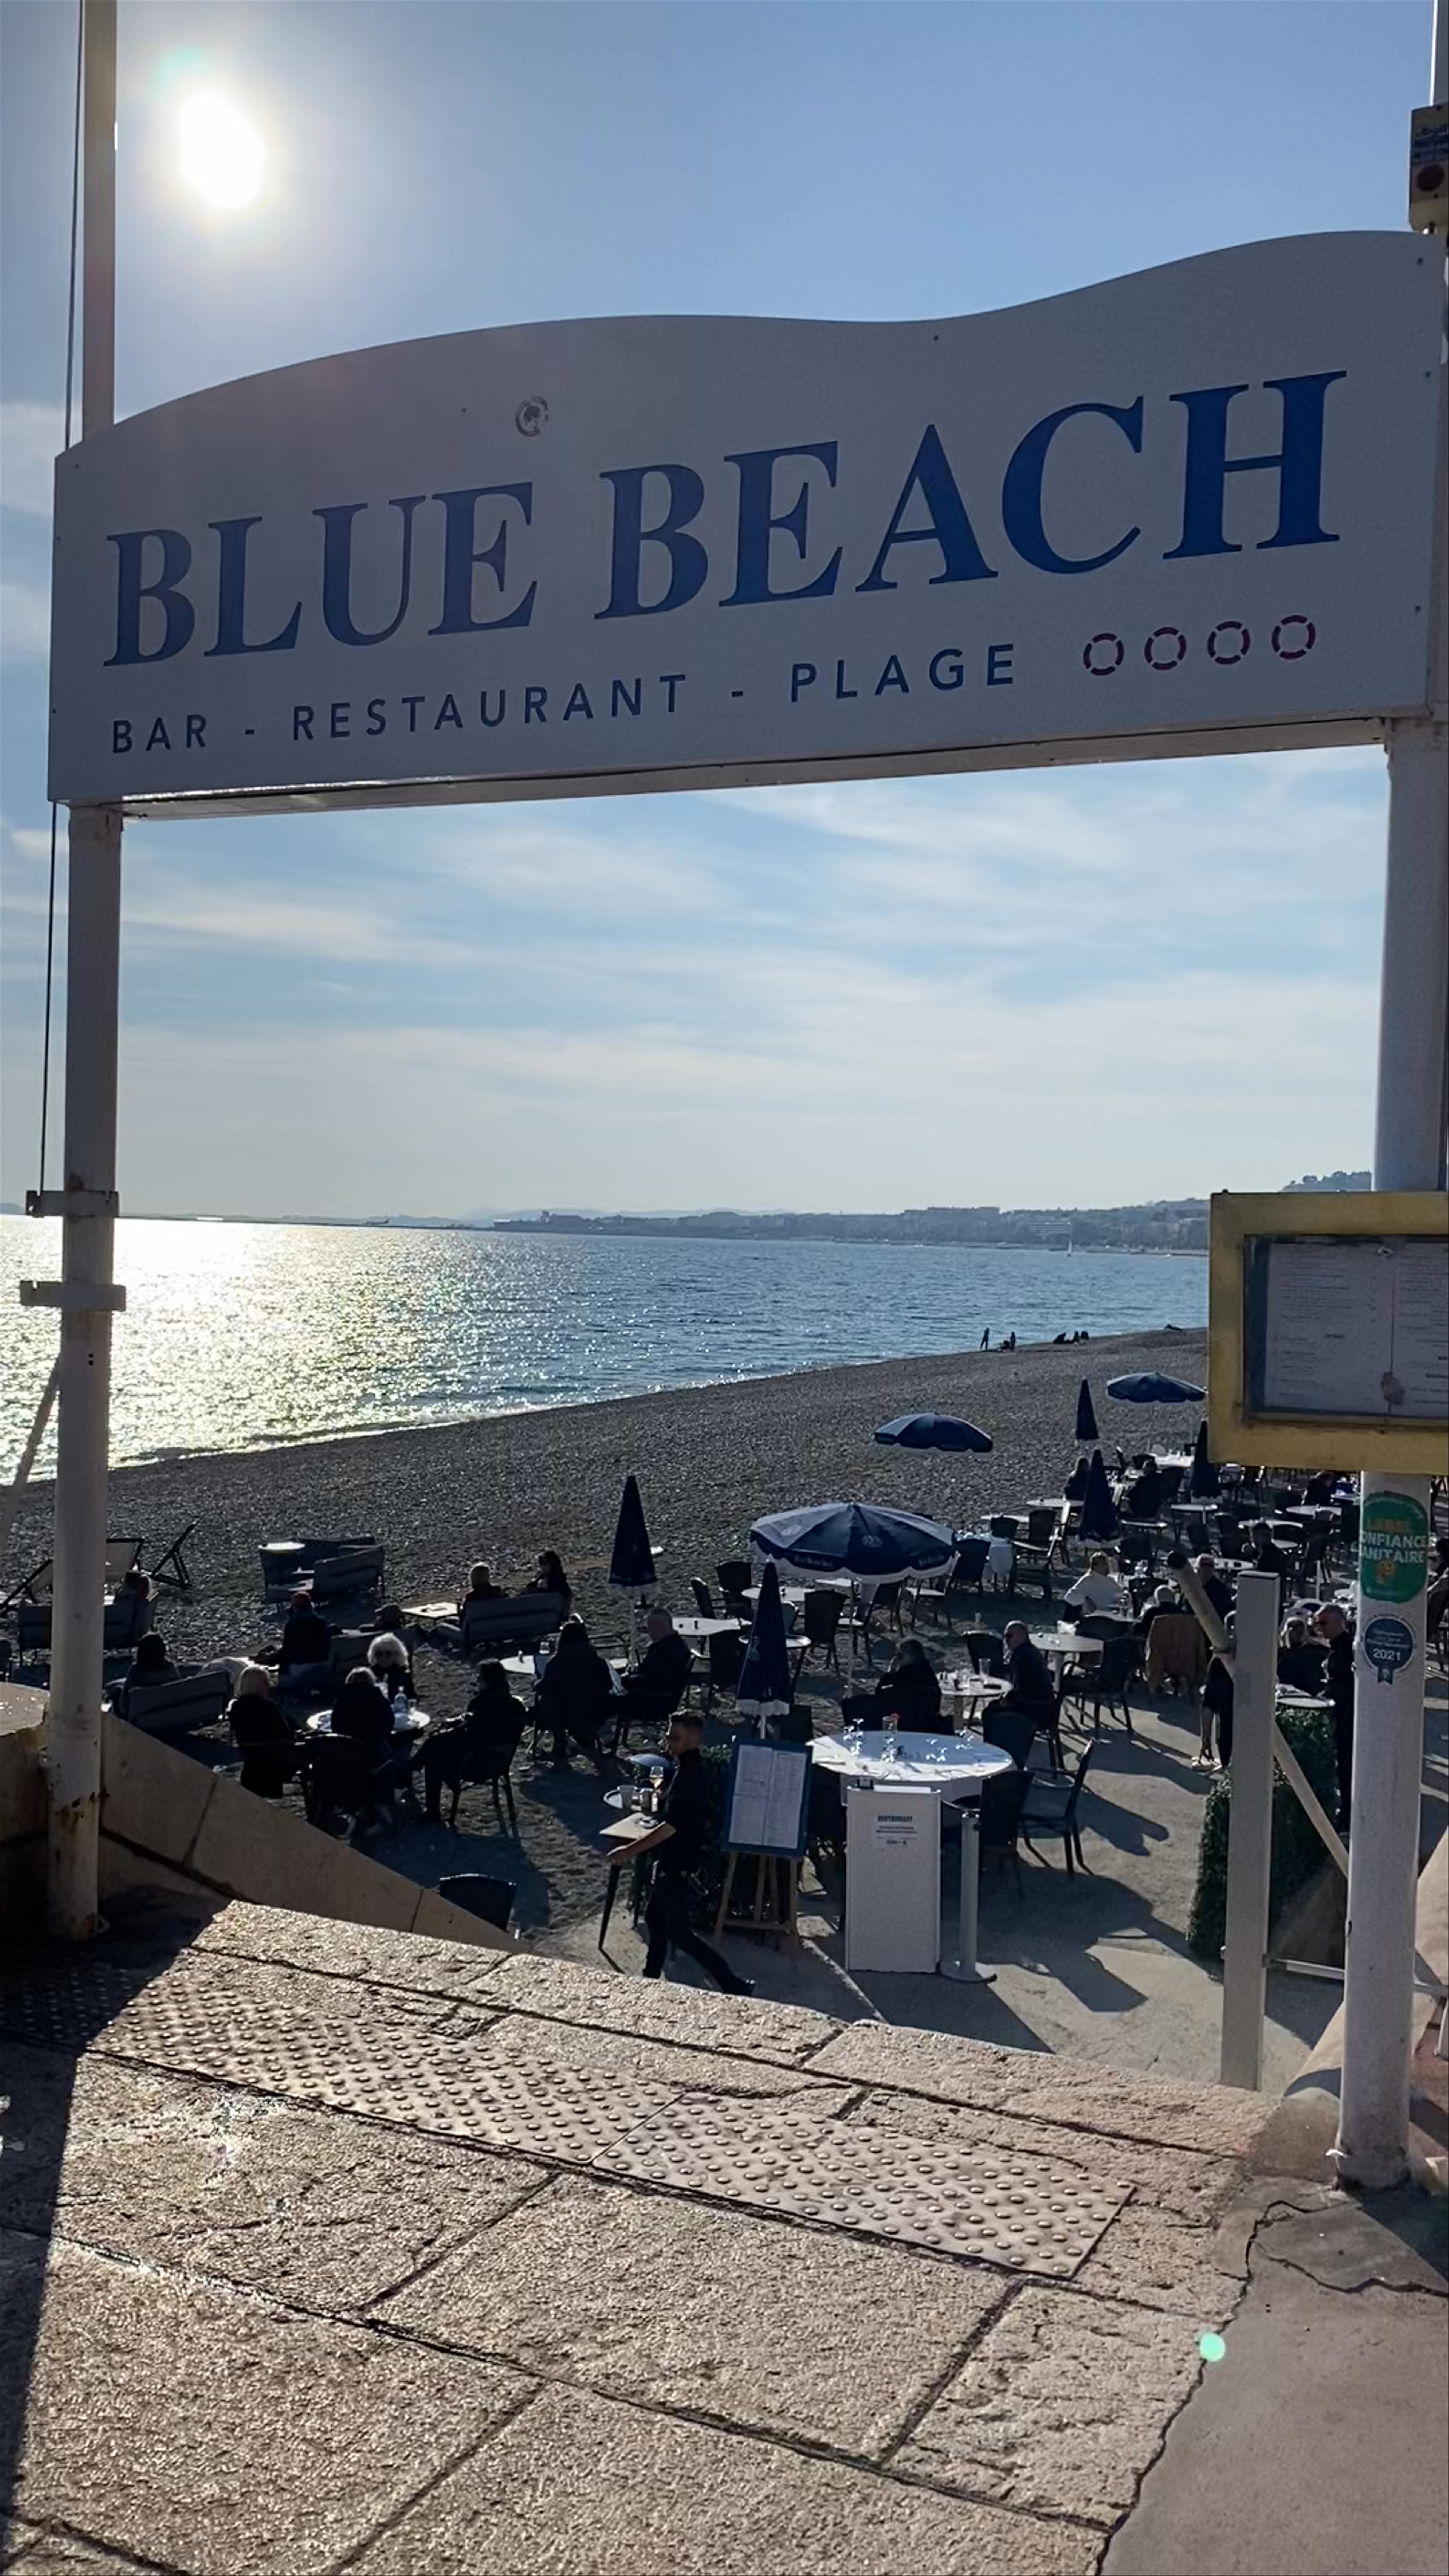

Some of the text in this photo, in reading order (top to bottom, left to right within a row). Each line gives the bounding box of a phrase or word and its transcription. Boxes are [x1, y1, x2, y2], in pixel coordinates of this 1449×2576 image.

[103, 370, 1347, 667] BLUE BEACH
[112, 714, 207, 754] BAR
[293, 674, 686, 741] RESTAURANT
[791, 643, 1014, 703] PLAGE
[1361, 1531, 1427, 1548] ONFIANCE
[1373, 1648, 1401, 1661] 2021
